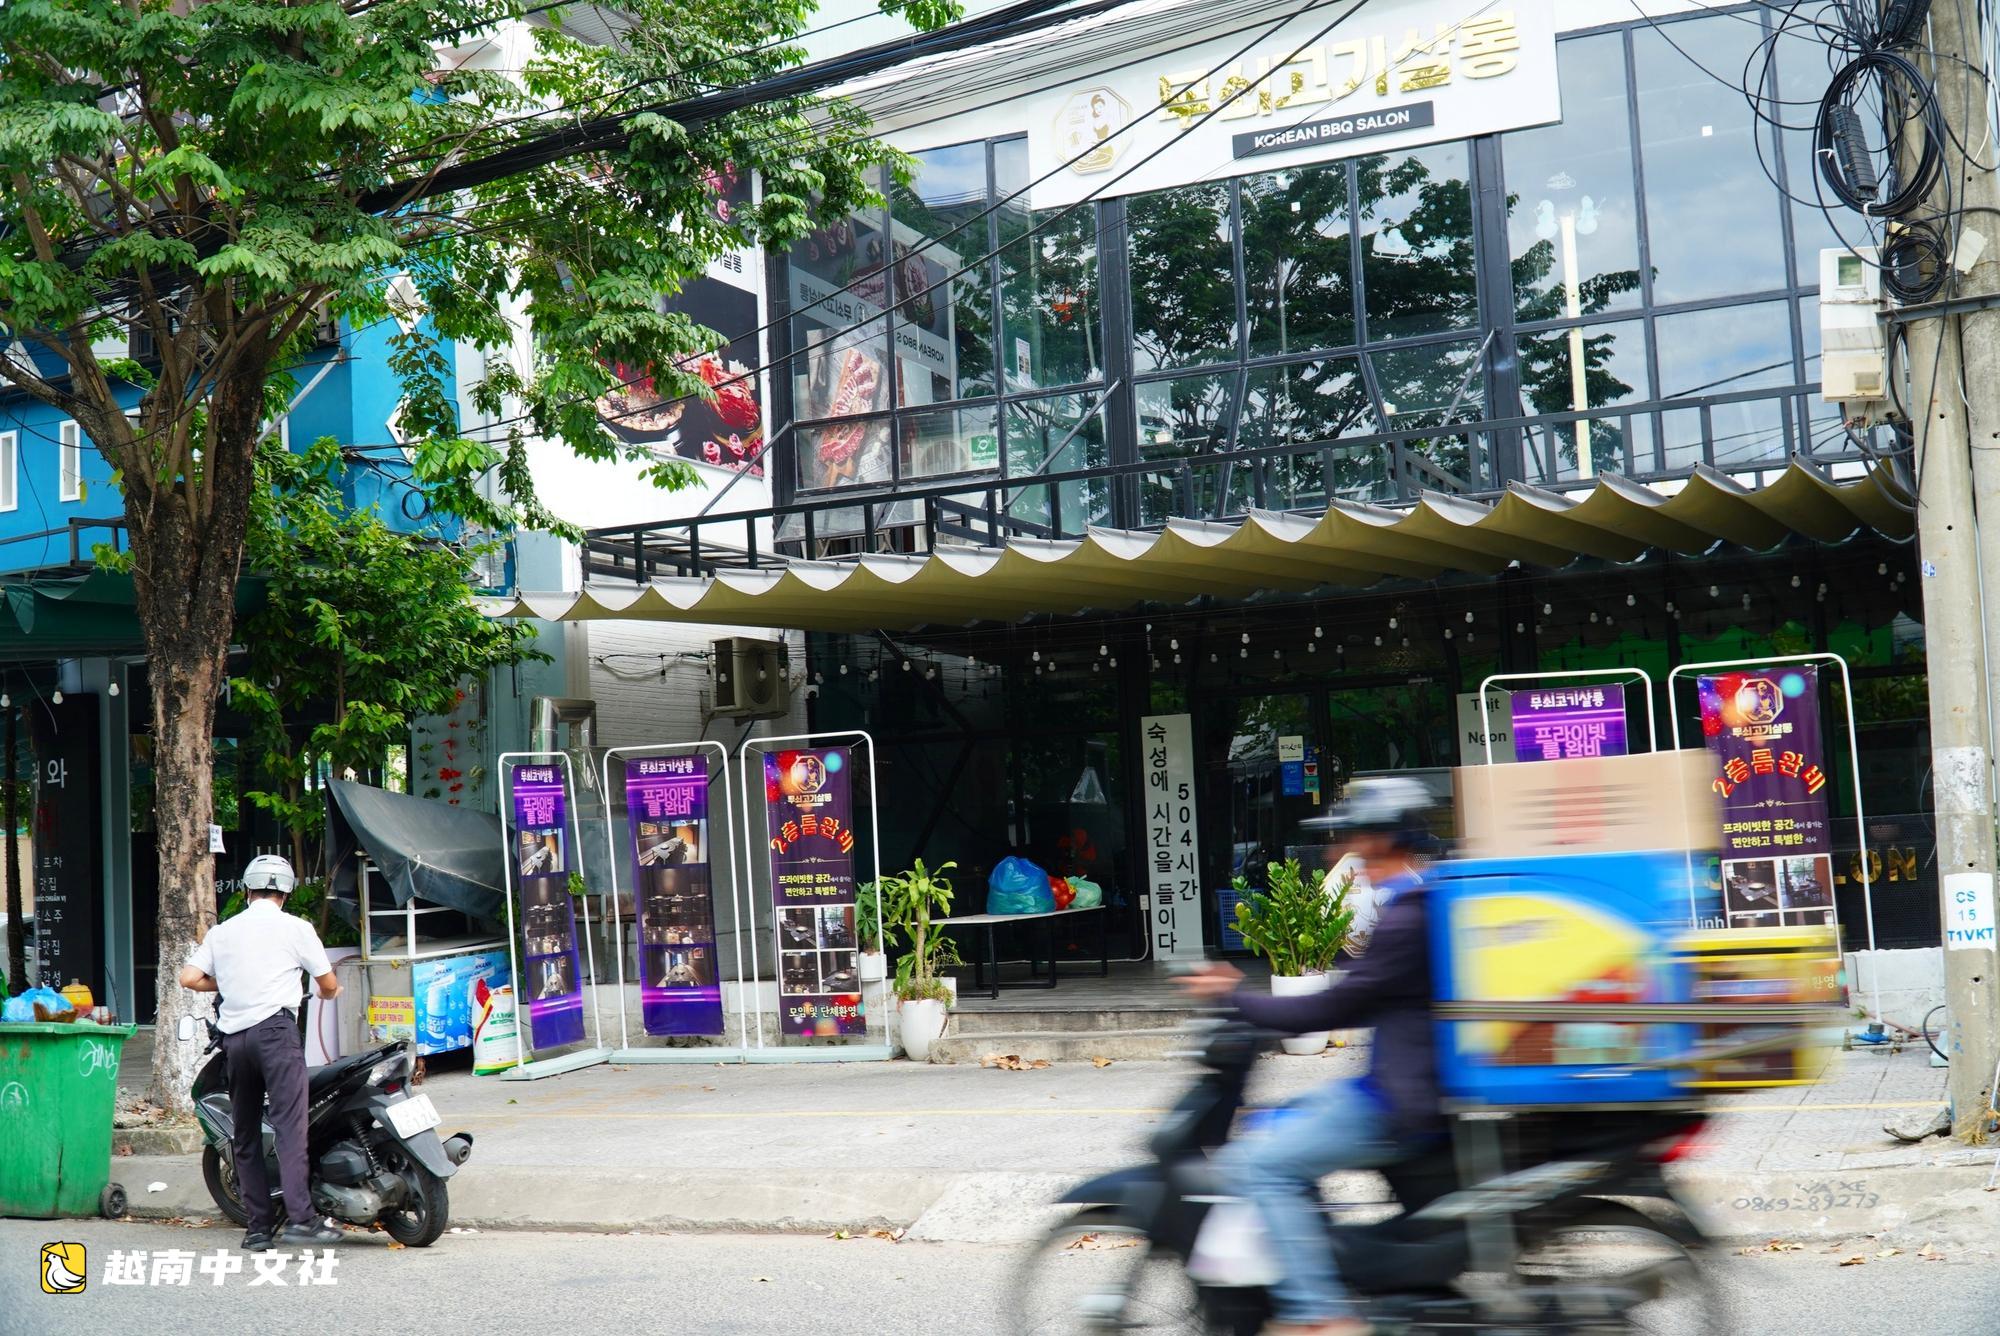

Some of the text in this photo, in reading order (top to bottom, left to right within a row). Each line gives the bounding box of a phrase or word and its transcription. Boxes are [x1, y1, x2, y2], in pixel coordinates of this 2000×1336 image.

[1158, 10, 1521, 130] 무쇠고기살롱
[1254, 110, 1411, 149] KOREAN BBQ SALON
[1535, 722, 1607, 744] 프라이빗
[1565, 738, 1601, 758] 완비
[643, 787, 695, 804] 프라이빗
[664, 800, 691, 816] 완비
[1147, 722, 1177, 954] 숙성에 시간을 들이다
[1732, 836, 1770, 848] 편안하고
[1773, 833, 1804, 845] 특별한
[1956, 891, 1976, 904] CS
[1959, 908, 1977, 921] 15
[1947, 928, 1994, 942] T1VKT
[788, 1007, 807, 1018] 모임
[809, 1007, 818, 1018] 및
